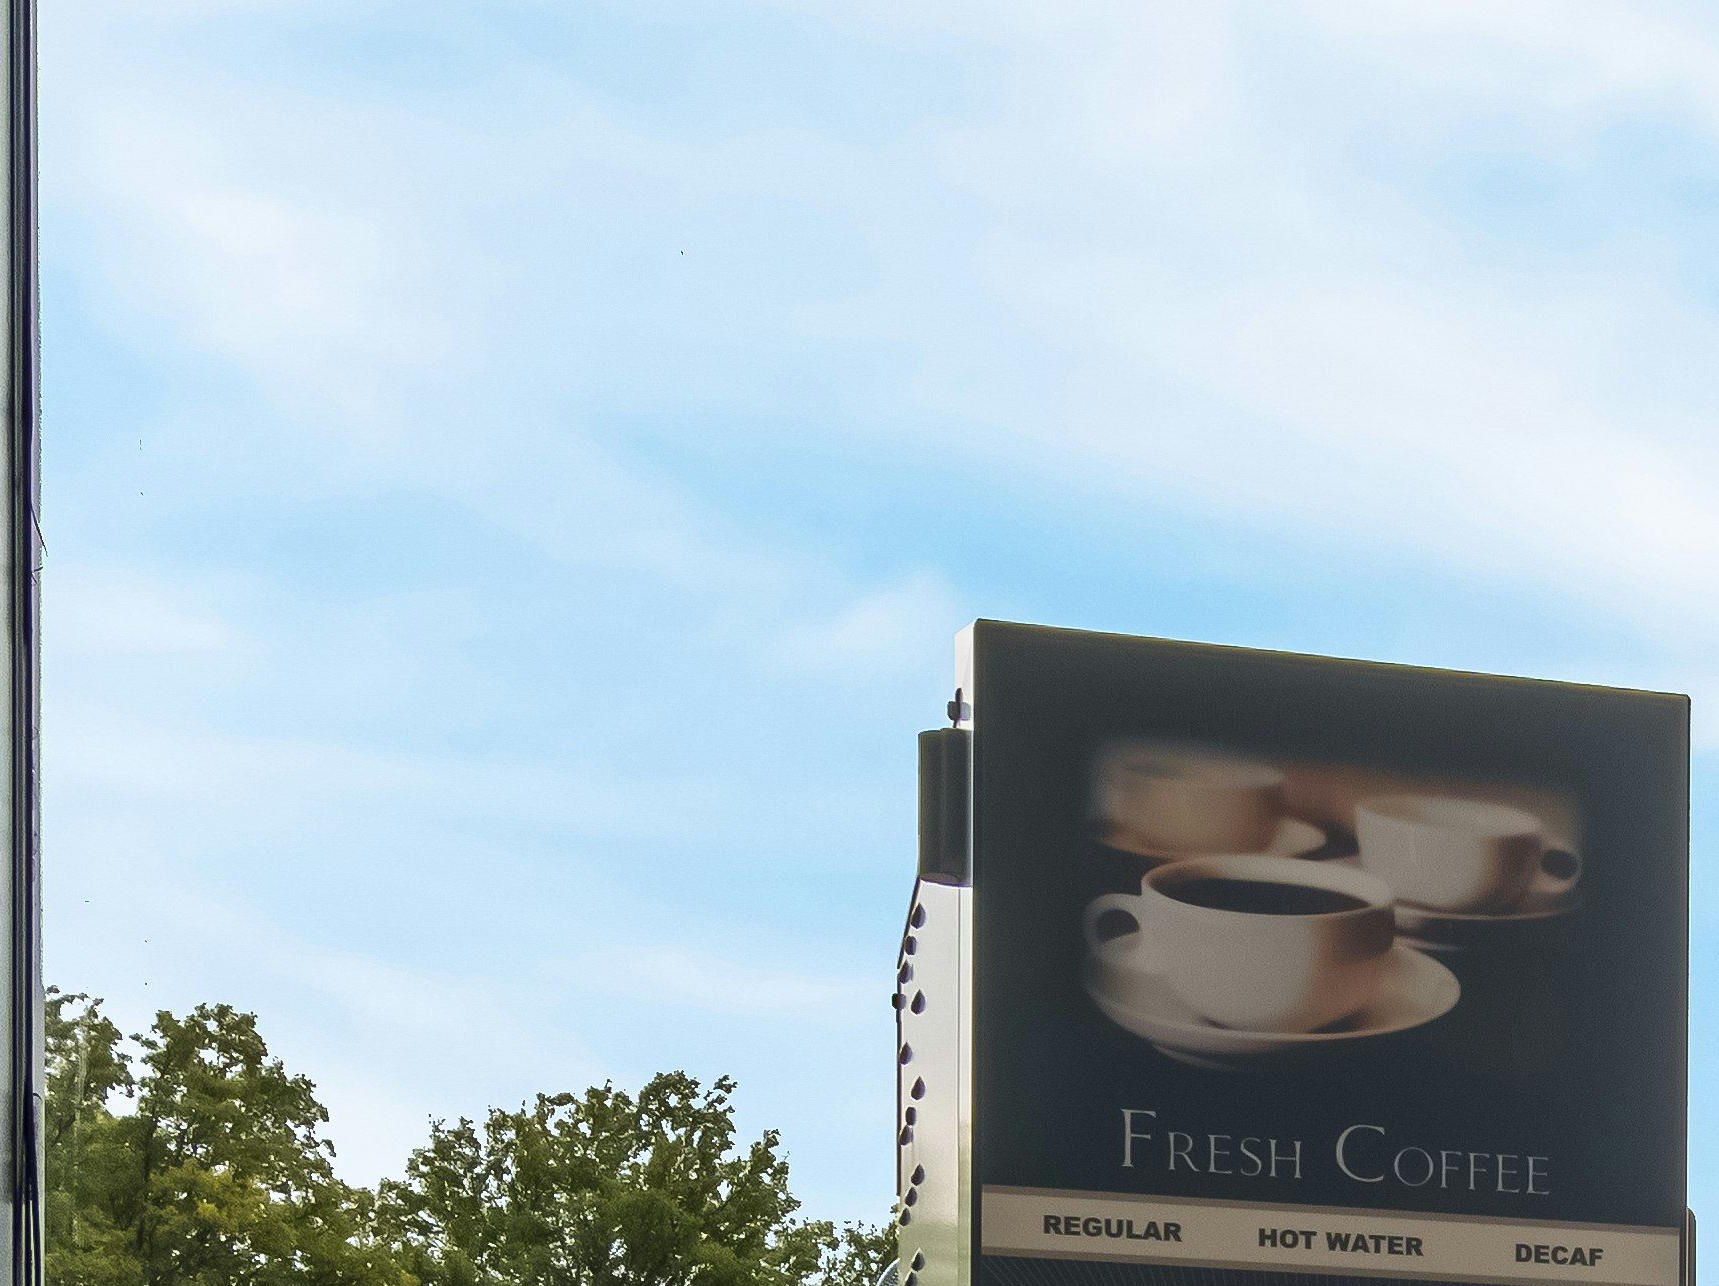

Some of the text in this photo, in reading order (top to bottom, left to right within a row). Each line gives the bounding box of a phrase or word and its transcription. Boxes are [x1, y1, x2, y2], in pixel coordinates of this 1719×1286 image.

[1042, 1213, 1604, 1268] REGULAR HOT WATER DECAF
